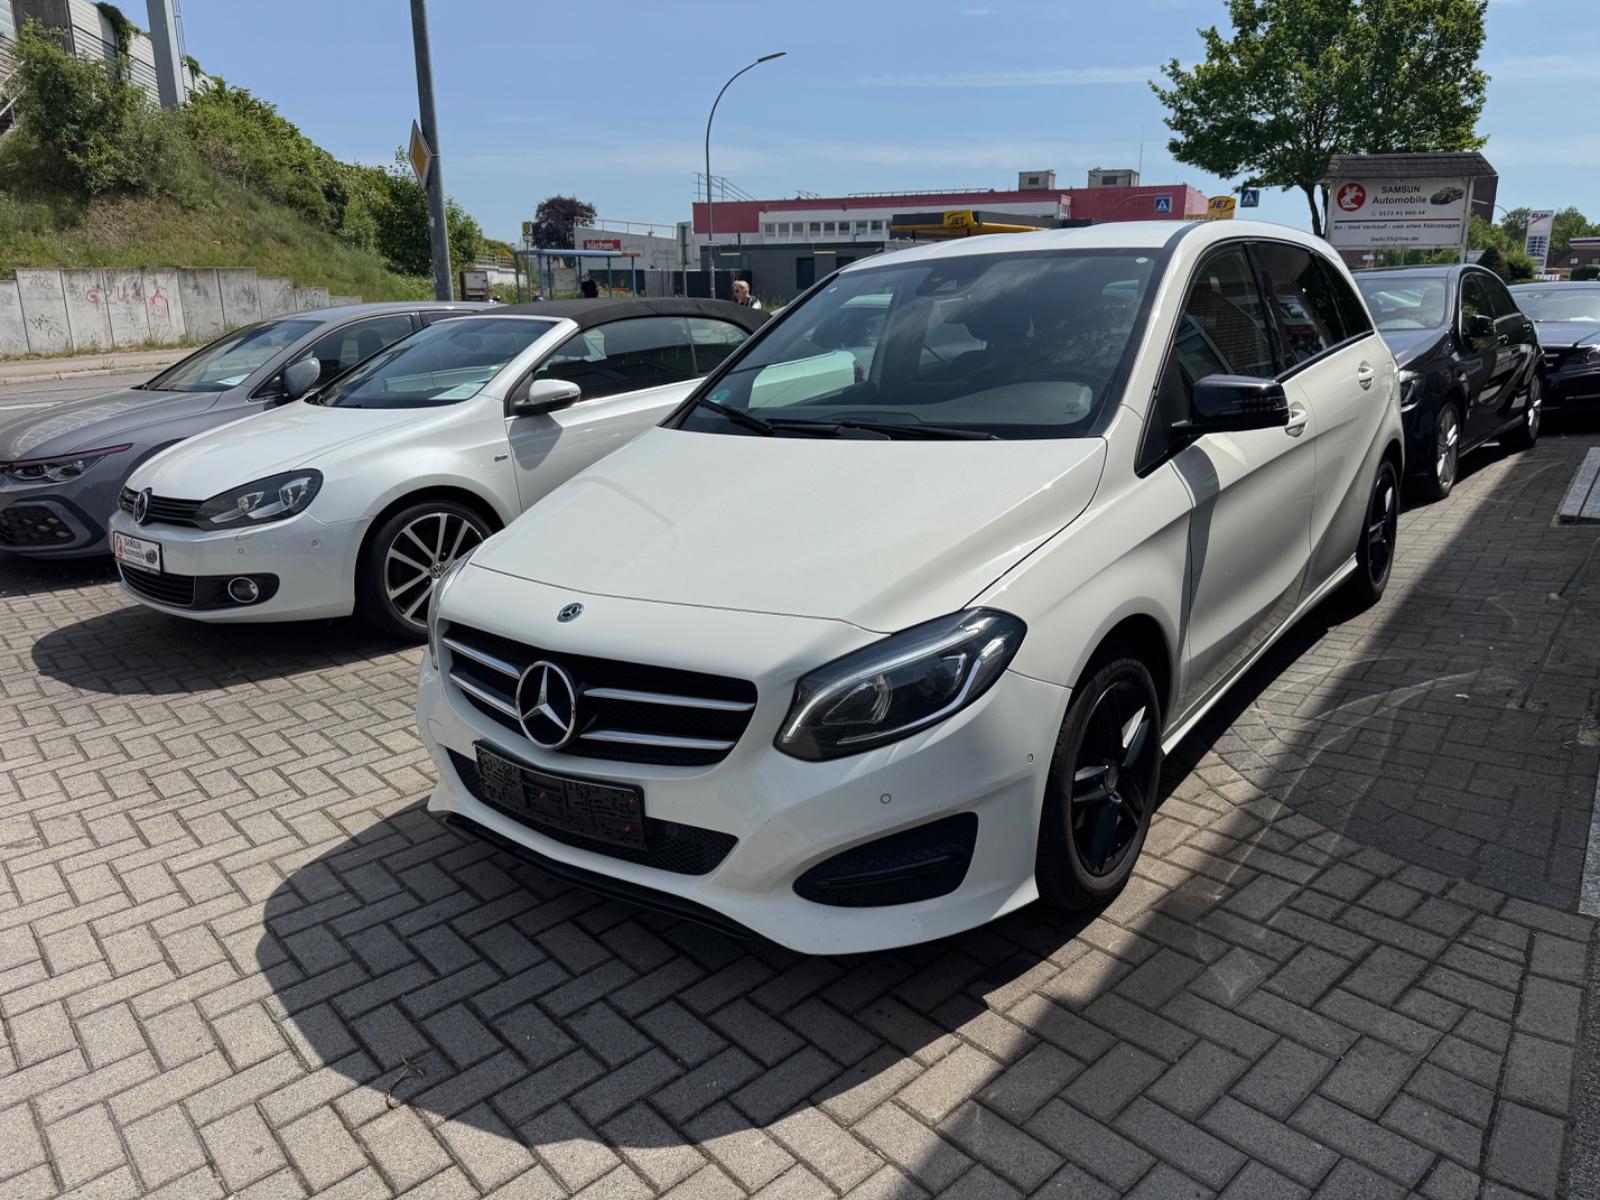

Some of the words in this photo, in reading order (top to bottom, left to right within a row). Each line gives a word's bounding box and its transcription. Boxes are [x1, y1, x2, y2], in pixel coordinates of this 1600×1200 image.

[1381, 185, 1421, 194] SAMSUN
[1210, 199, 1231, 209] JET
[1371, 195, 1427, 205] Automobile
[951, 216, 966, 225] JET
[1423, 222, 1460, 230] Fahrzeugen
